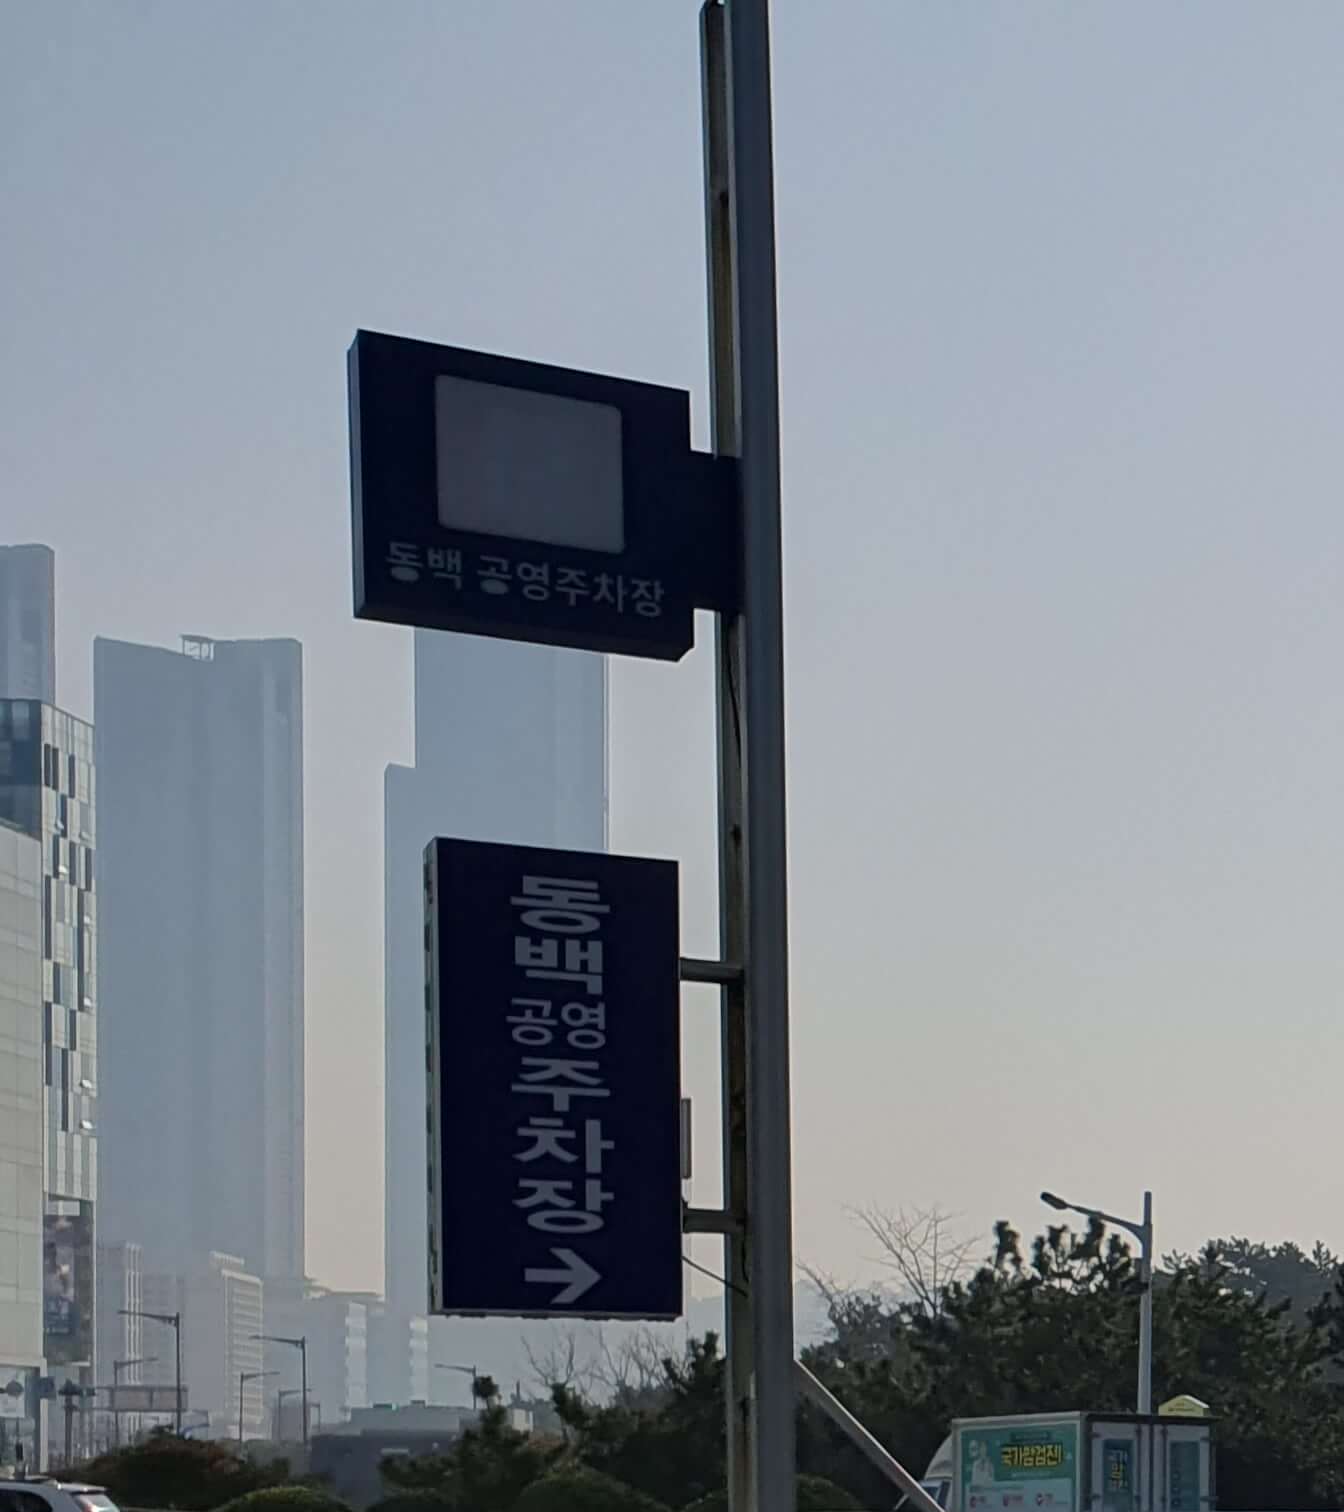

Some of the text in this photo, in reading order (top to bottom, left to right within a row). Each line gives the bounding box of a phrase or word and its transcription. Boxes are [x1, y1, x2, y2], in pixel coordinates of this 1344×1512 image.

[384, 540, 665, 617] 동백 공영주차장
[509, 875, 611, 994] 동백
[506, 996, 607, 1050] 공영
[510, 1056, 616, 1235] 주차장
